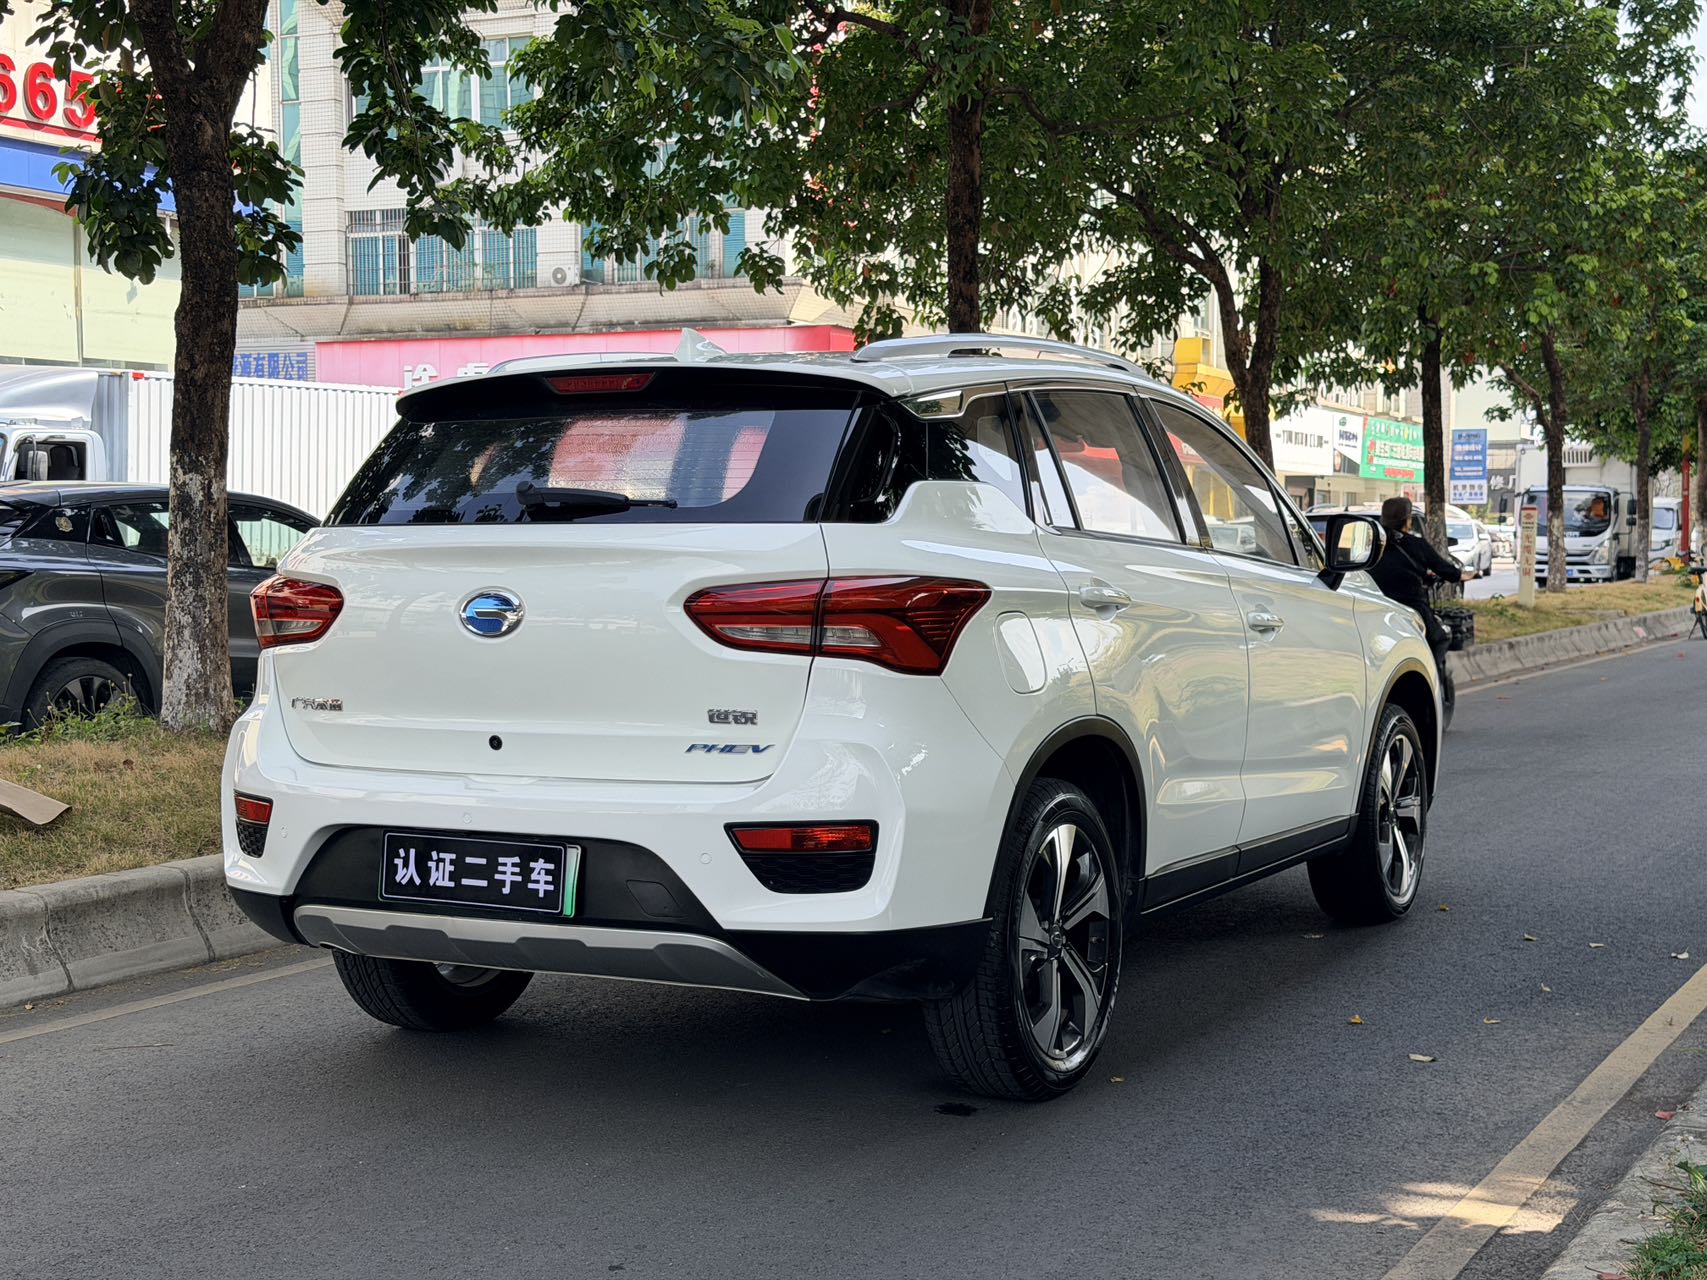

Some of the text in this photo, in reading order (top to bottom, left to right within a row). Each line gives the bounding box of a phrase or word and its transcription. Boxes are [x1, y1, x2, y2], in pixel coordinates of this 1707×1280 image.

[684, 743, 776, 754] PHEV
[393, 848, 556, 899] 认证二手车
